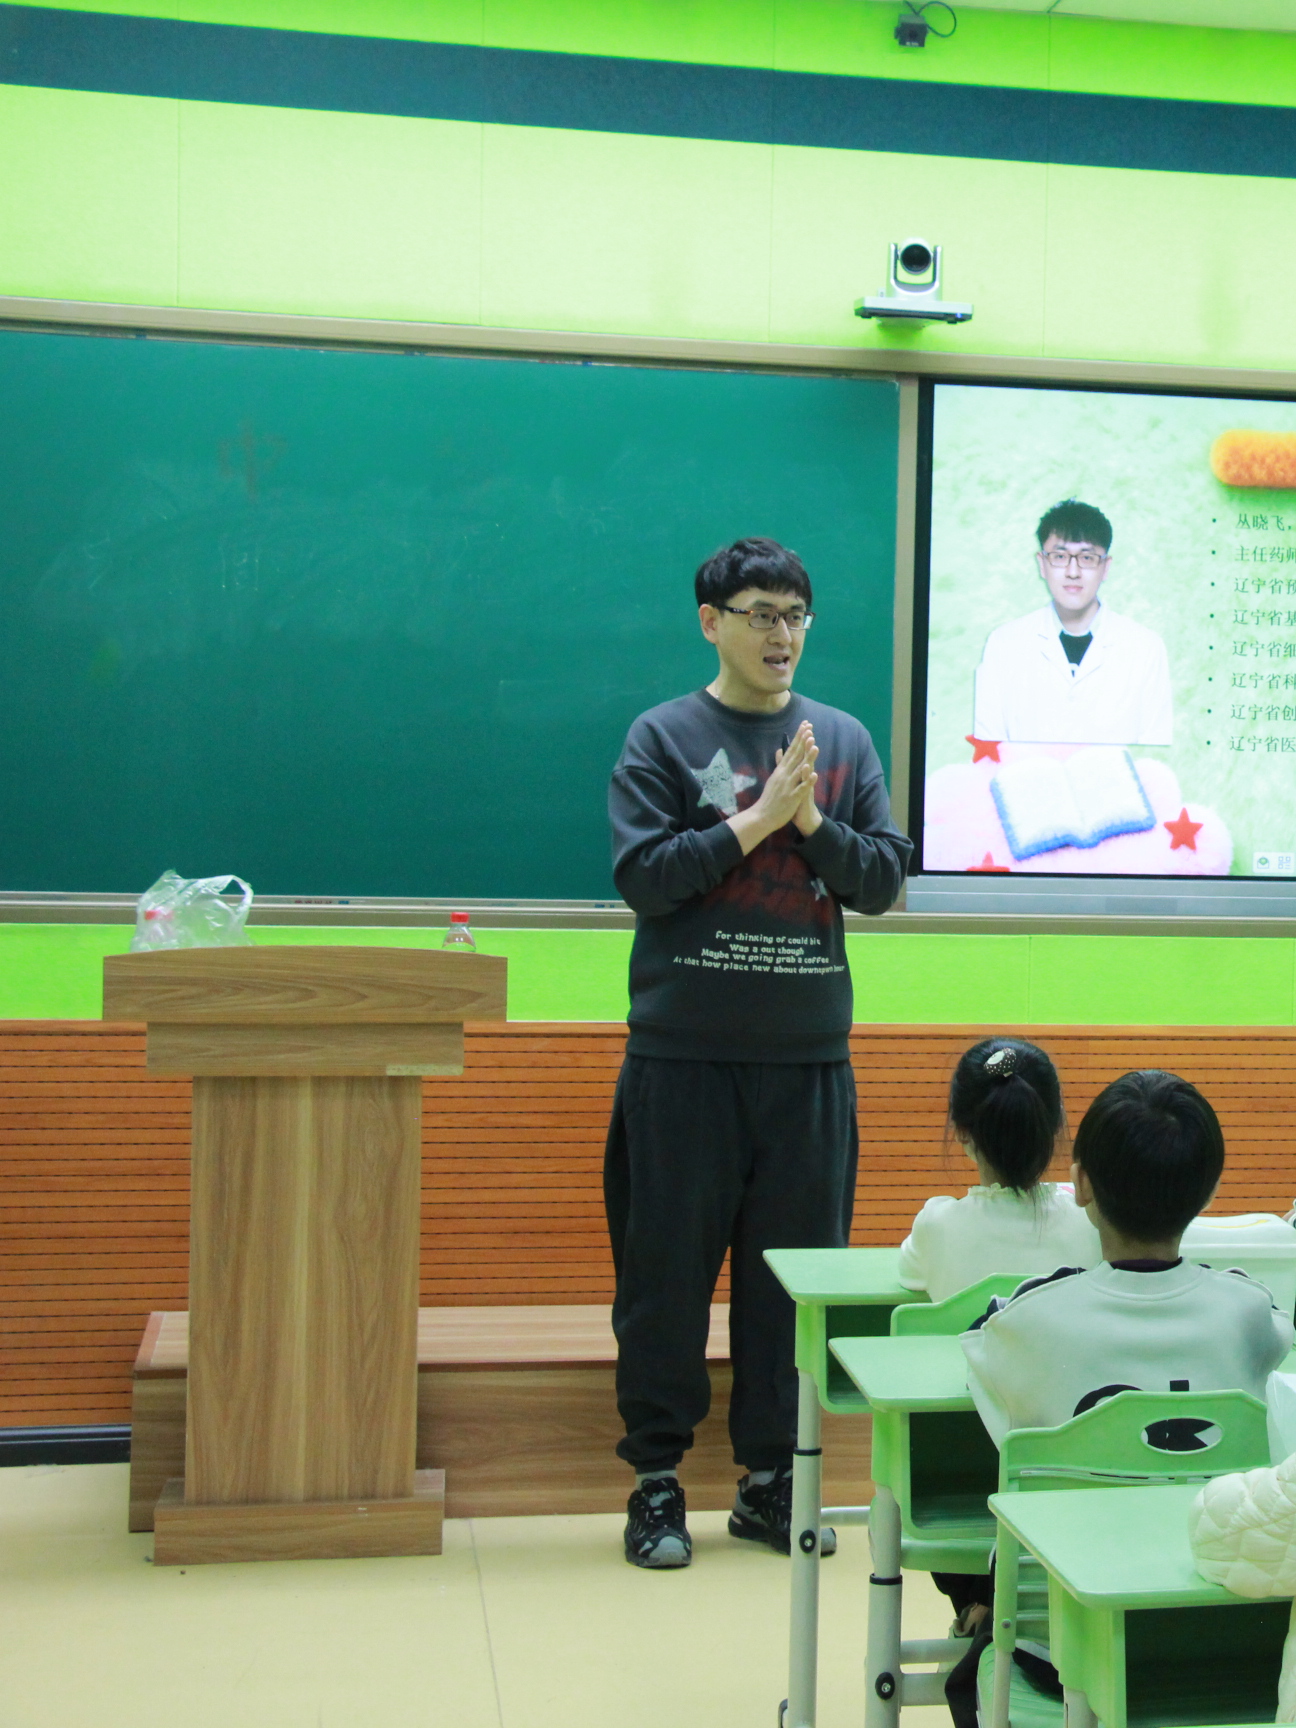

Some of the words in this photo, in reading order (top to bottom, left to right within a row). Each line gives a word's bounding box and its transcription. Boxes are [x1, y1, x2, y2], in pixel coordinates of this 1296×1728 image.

[715, 930, 732, 940] For
[735, 933, 773, 944] thinking
[788, 937, 808, 945] could
[701, 948, 729, 960] Maybe
[748, 954, 773, 964] going
[775, 956, 795, 965] grab
[729, 944, 749, 953] Was
[777, 947, 804, 956] though
[684, 957, 699, 966] that
[702, 959, 721, 968] how
[723, 962, 749, 971] place
[773, 965, 797, 974] about
